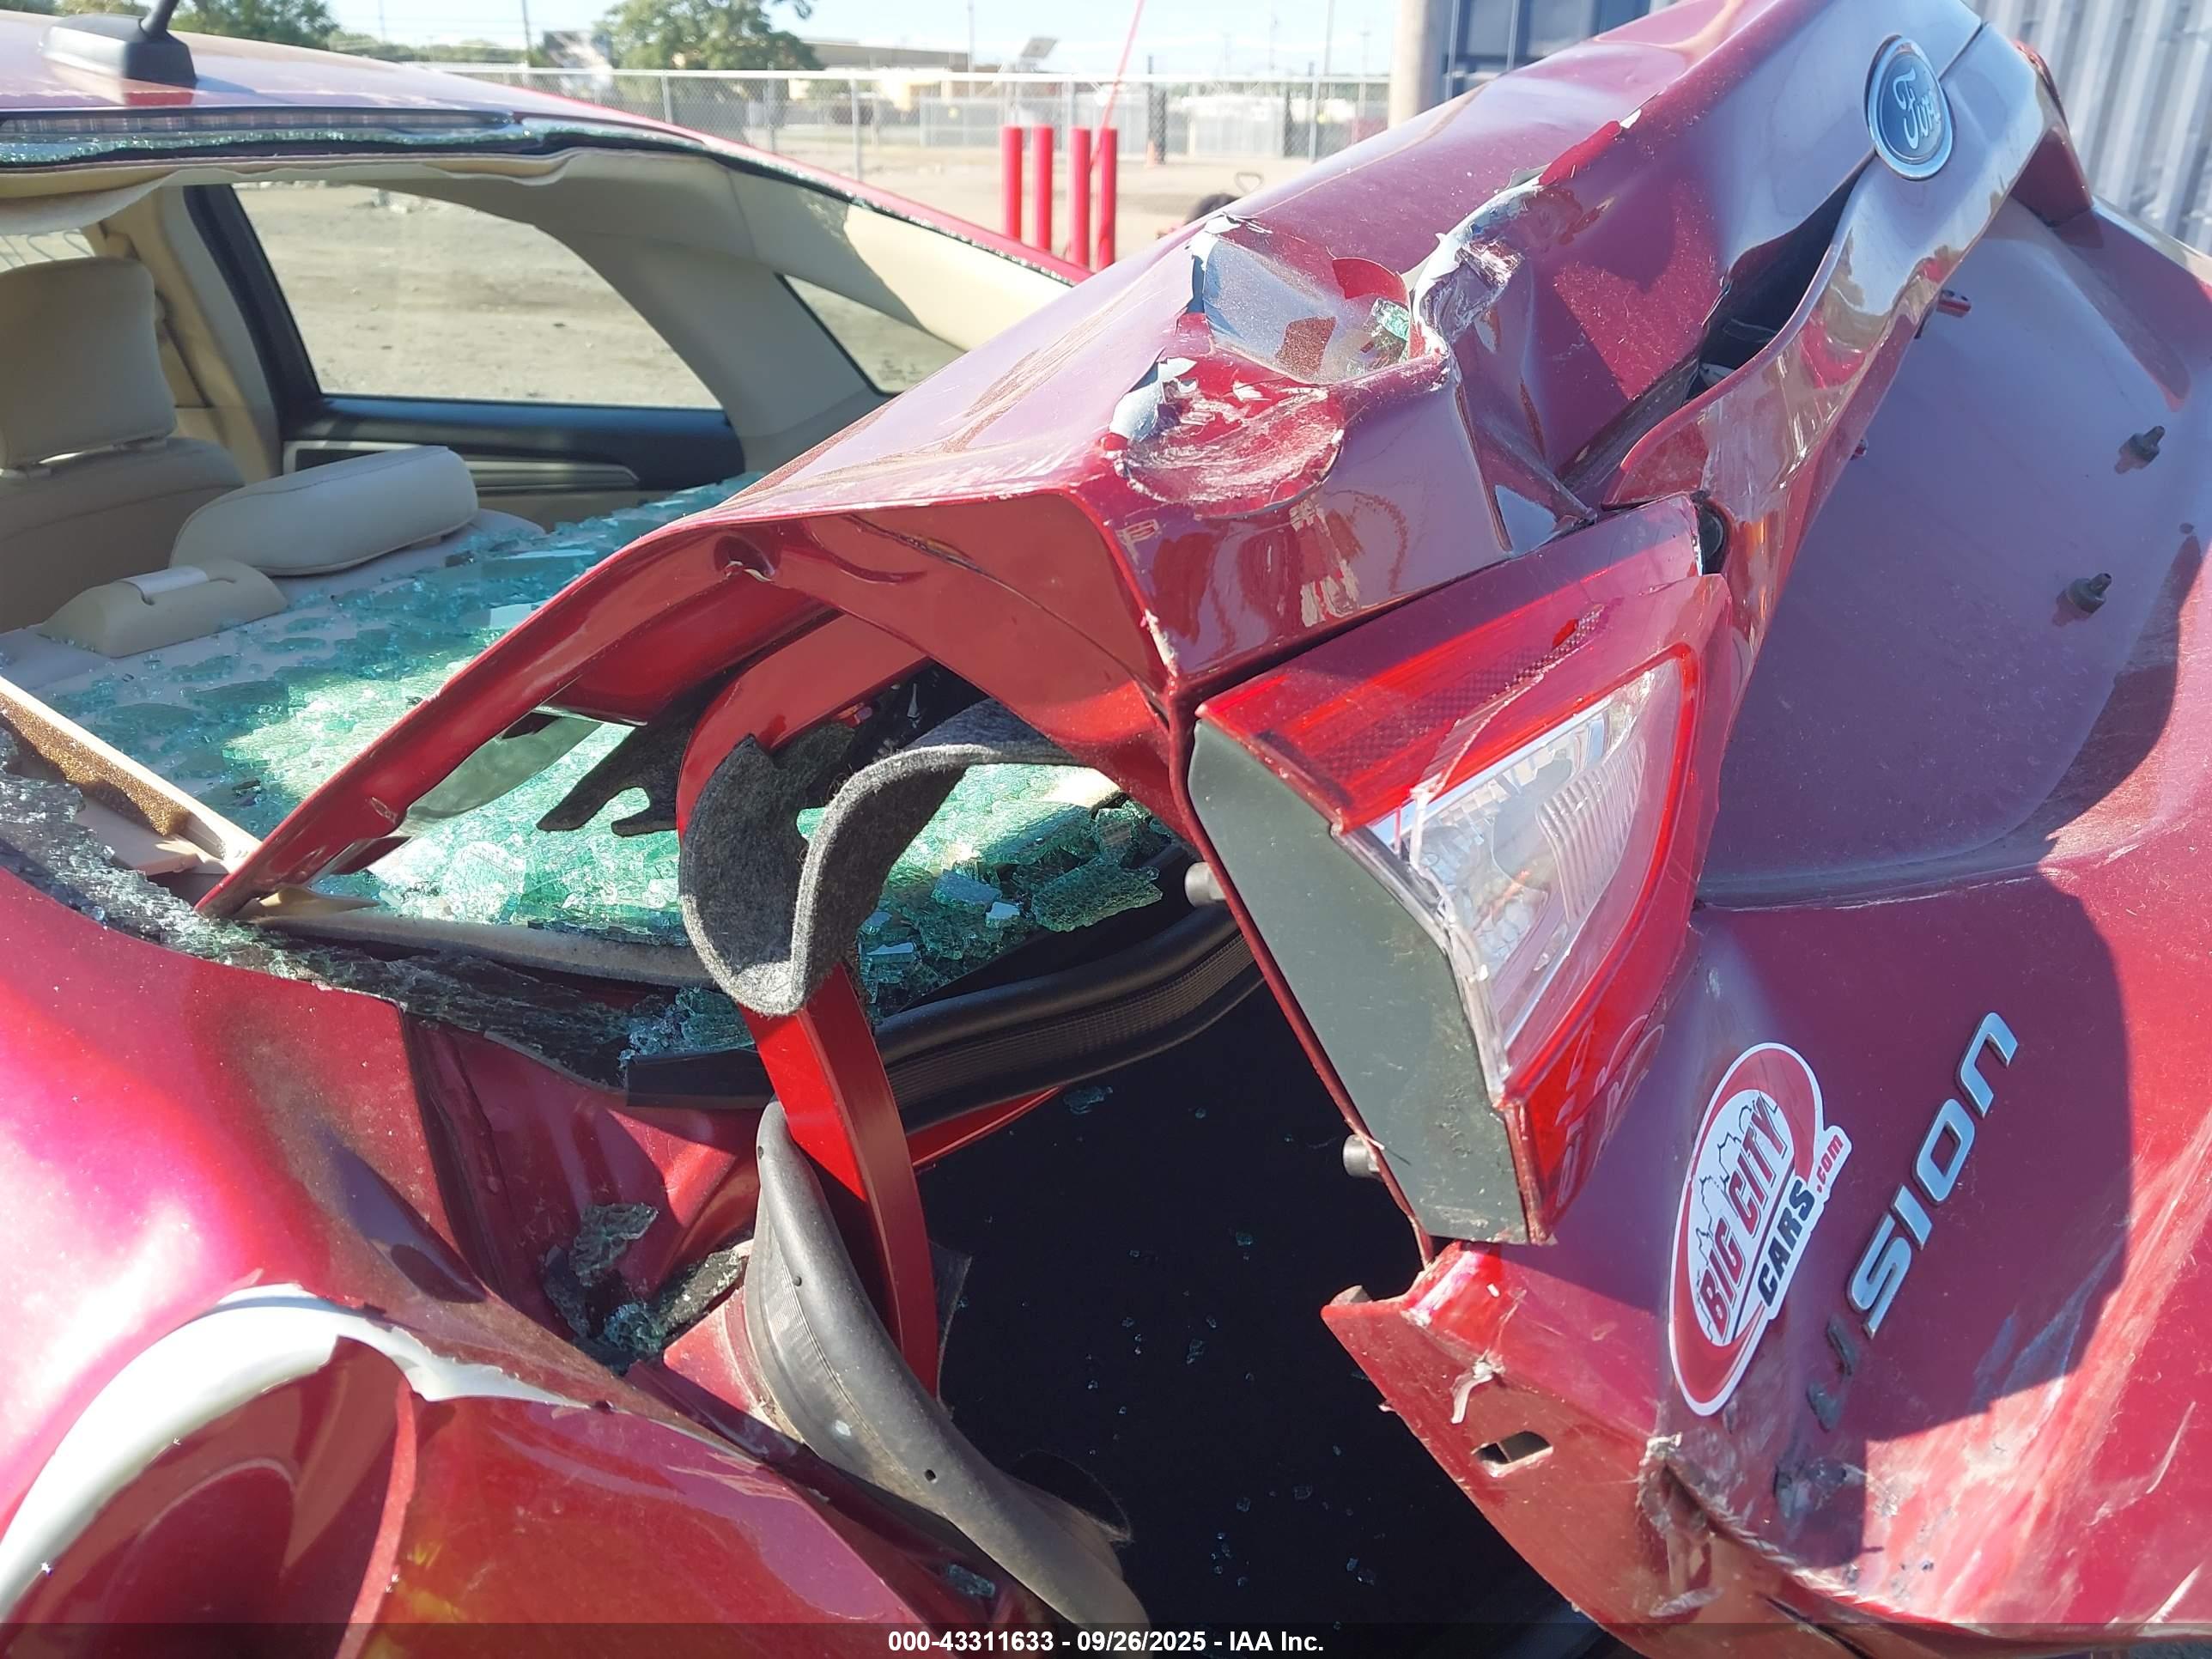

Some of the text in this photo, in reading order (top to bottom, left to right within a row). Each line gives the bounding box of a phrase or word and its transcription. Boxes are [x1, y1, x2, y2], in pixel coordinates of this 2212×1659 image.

[1893, 67, 1941, 149] Ford
[1699, 1095, 1788, 1340] BIG CITY
